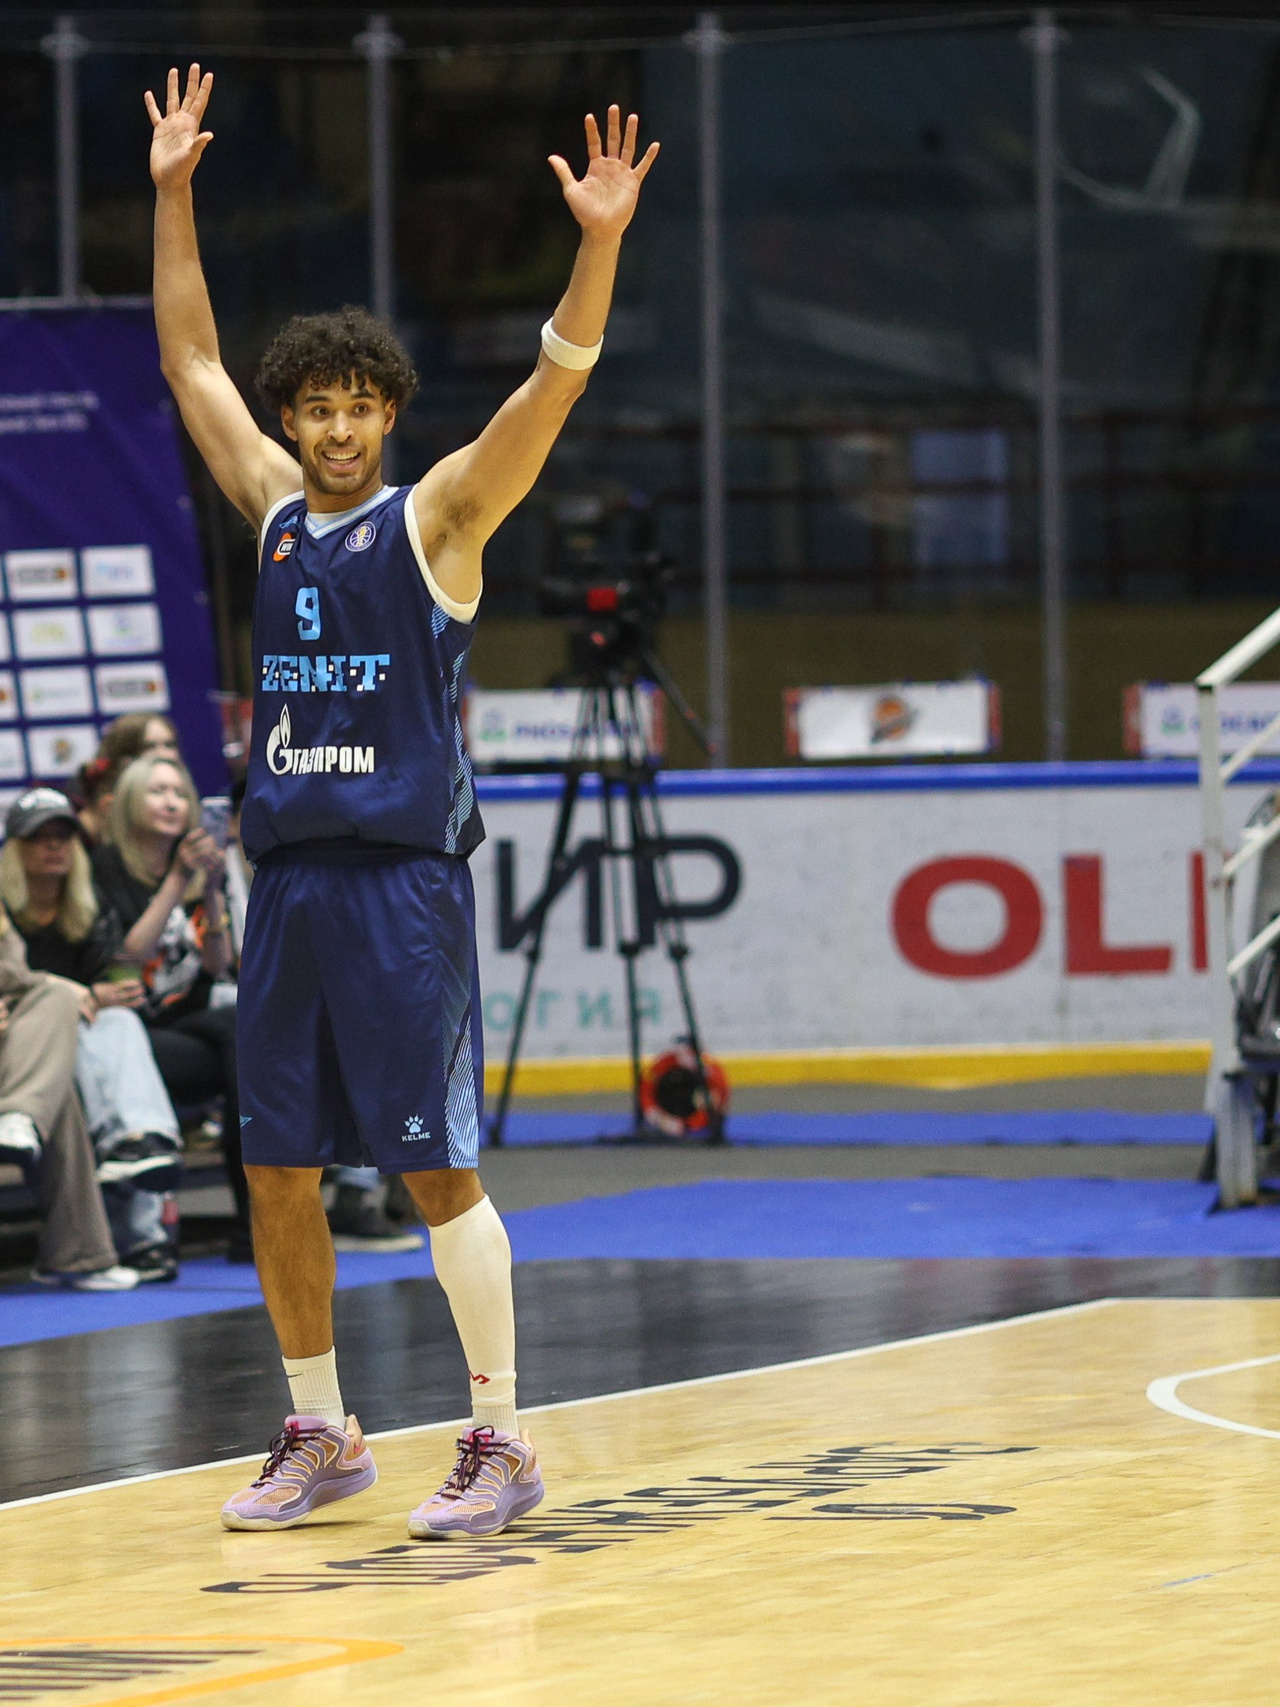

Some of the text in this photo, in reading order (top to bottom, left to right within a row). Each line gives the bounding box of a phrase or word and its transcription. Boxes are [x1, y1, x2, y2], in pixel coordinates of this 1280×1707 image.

[294, 586, 321, 641] 9
[261, 653, 391, 693] ZENIT
[401, 1131, 431, 1143] KELME
[200, 1446, 1039, 1594] ЗАРУБЕЖНЕФТЬ
